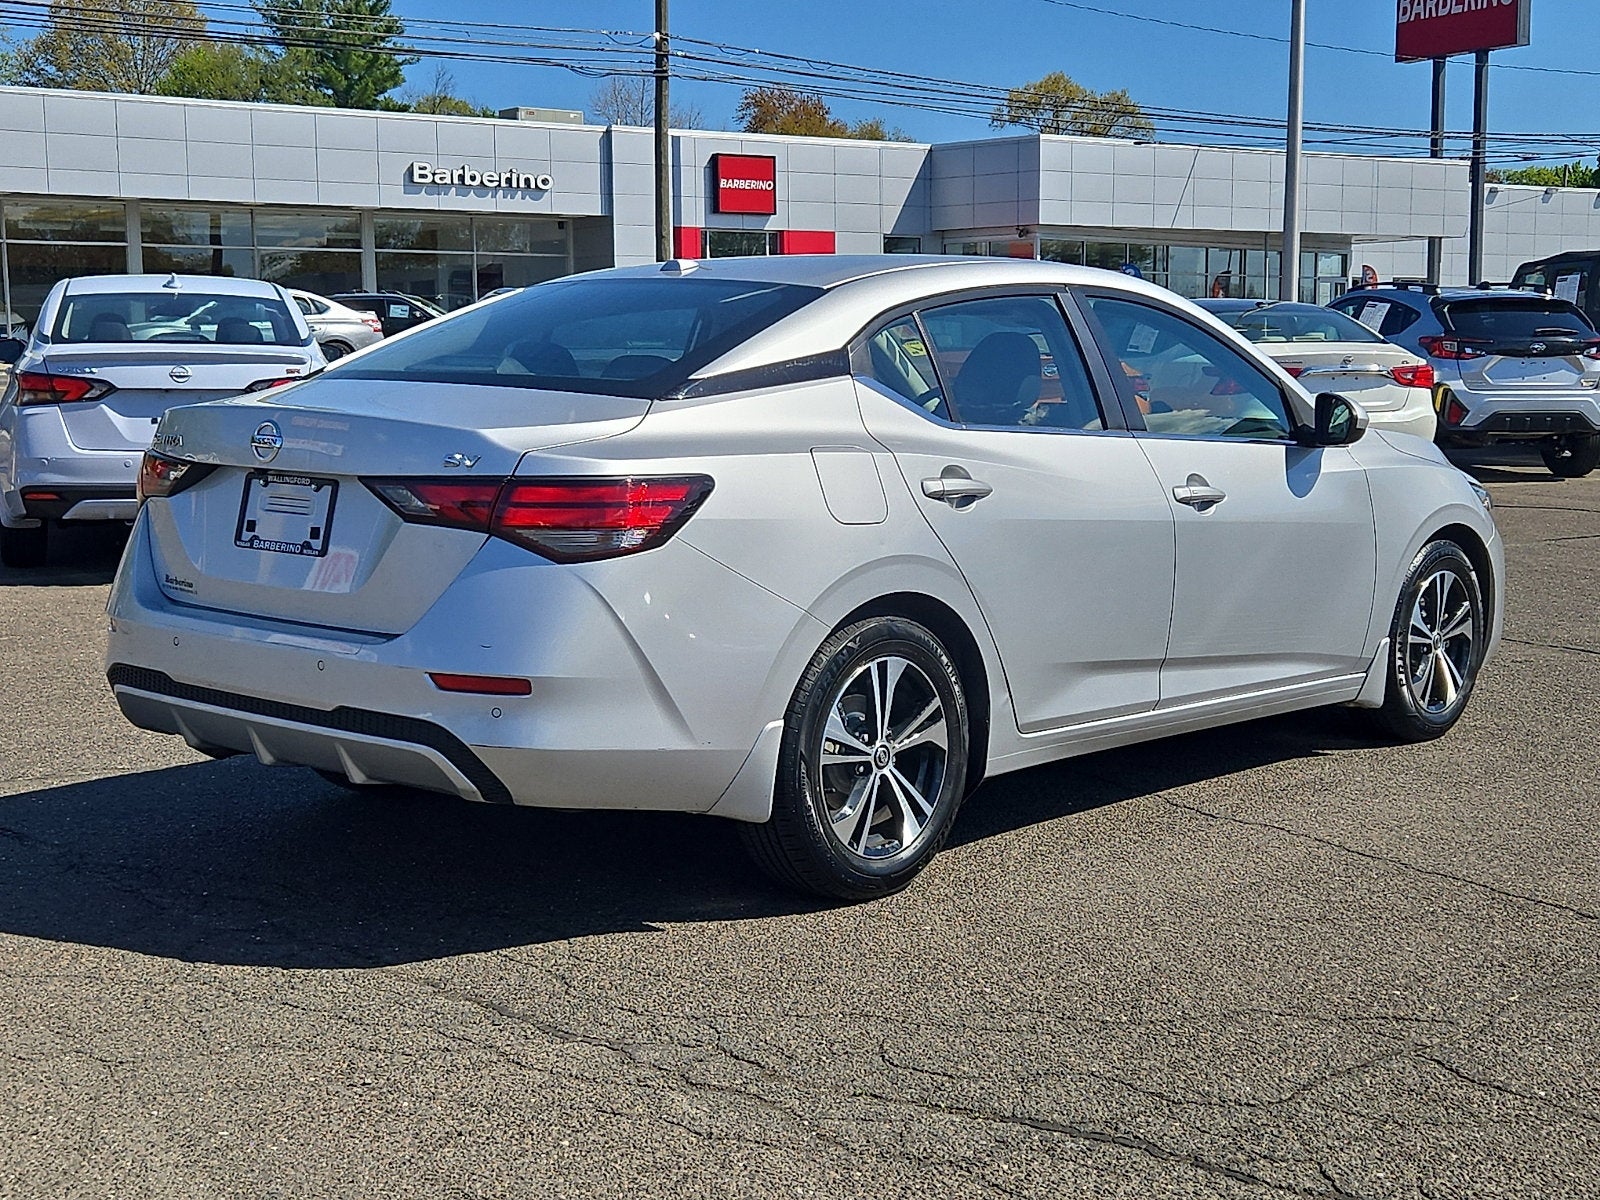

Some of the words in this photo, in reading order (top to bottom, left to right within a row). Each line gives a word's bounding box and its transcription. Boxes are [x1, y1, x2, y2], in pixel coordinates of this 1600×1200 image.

[1398, 0, 1513, 23] BARBE
[412, 161, 554, 190] Barberino
[720, 178, 774, 190] BARBERINO
[443, 453, 481, 468] SV
[267, 475, 311, 486] WALLINGFORD
[252, 540, 302, 554] BARBERINO
